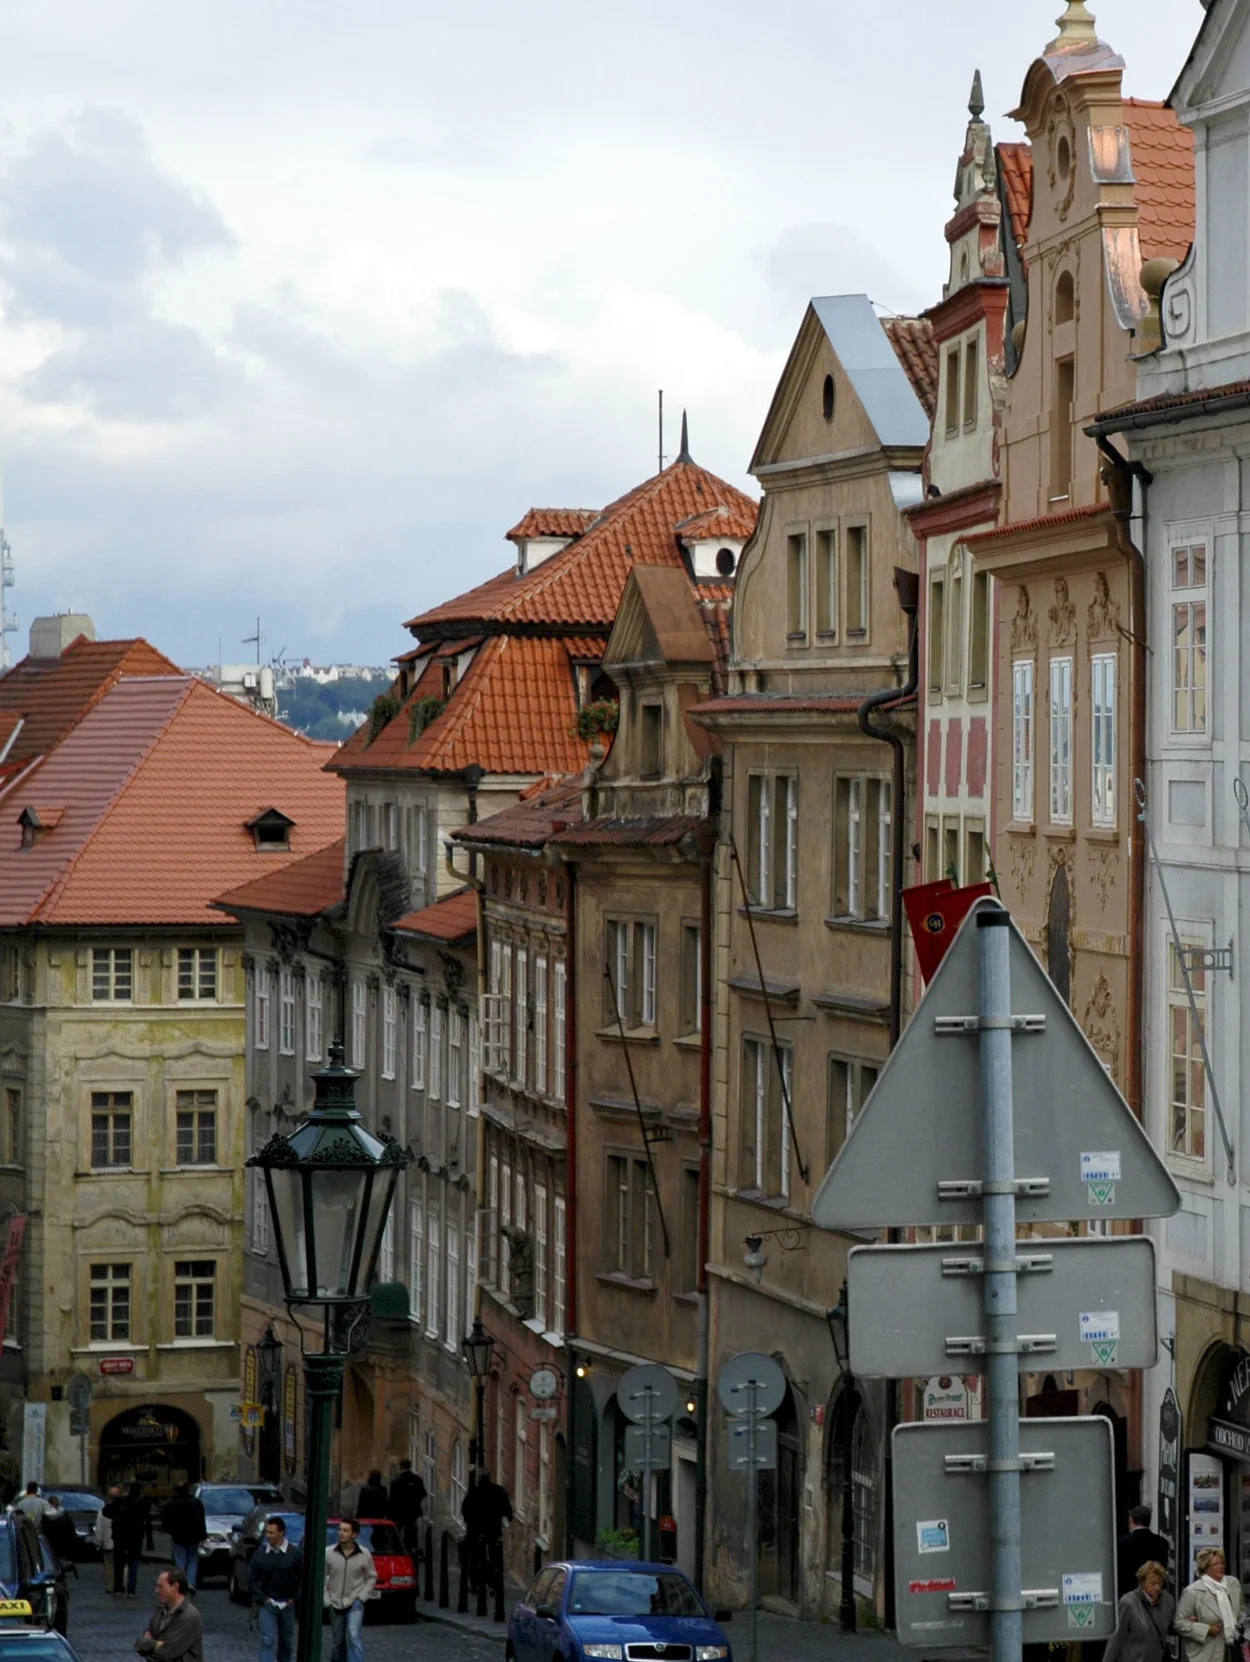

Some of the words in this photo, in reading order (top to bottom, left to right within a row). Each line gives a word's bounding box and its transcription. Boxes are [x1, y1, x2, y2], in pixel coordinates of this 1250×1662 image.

[925, 1408, 966, 1418] RESTAURACE
[1215, 1426, 1245, 1451] OBCHOD
[0, 1602, 25, 1610] AXI
